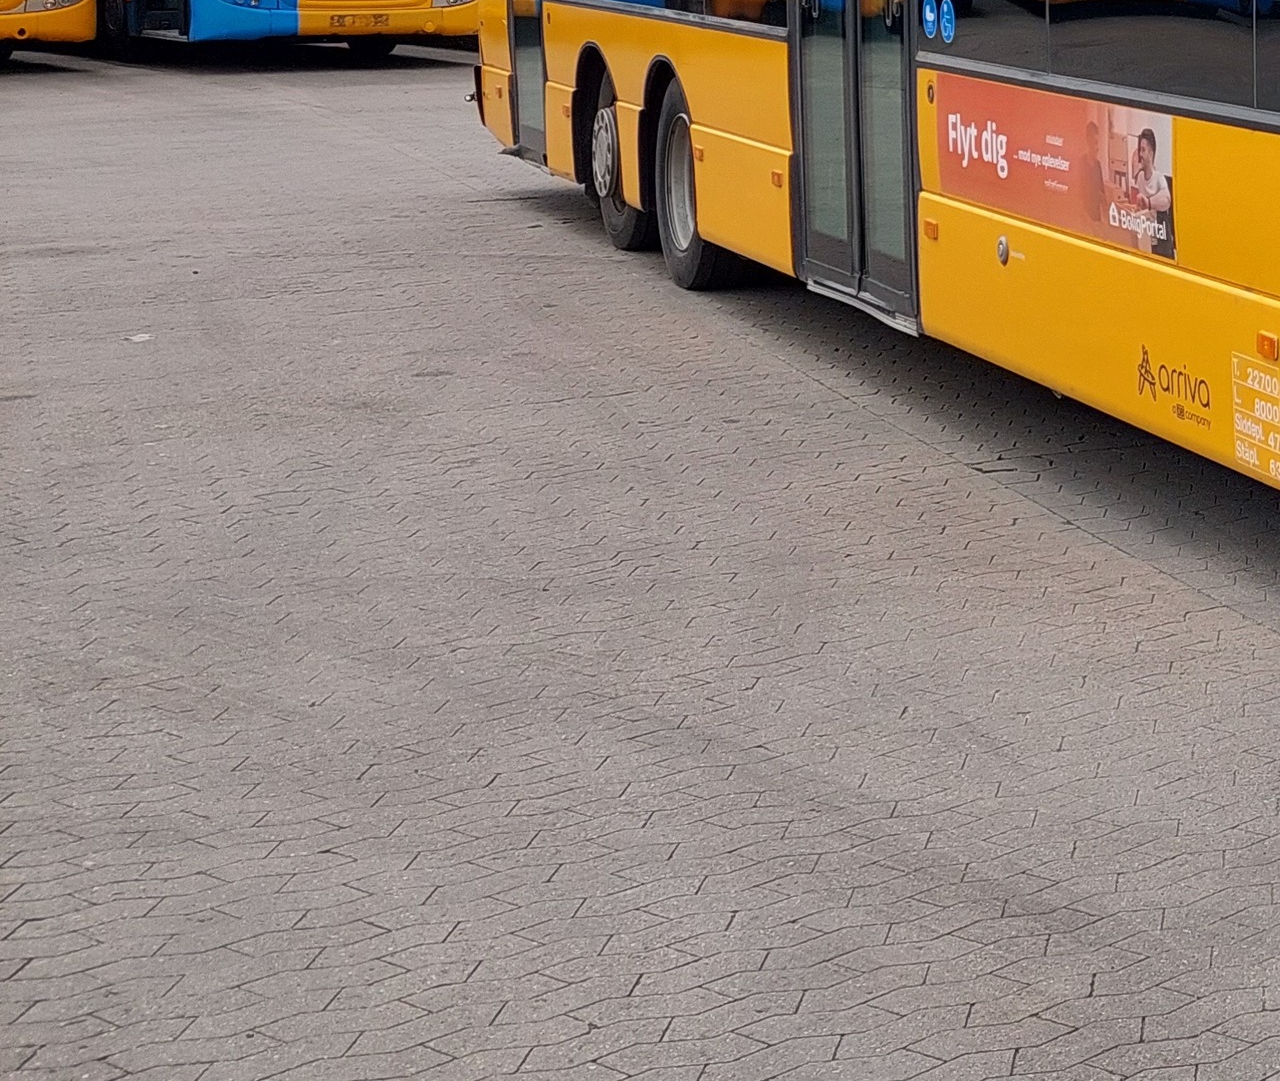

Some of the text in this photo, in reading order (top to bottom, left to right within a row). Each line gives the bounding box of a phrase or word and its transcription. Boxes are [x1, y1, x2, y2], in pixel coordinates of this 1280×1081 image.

[947, 113, 1009, 179] Flyt dig
[1120, 209, 1167, 241] BoligPortal
[1158, 363, 1211, 410] arriva
[1232, 358, 1279, 396] T. 22700
[1185, 409, 1212, 431] company
[1233, 385, 1280, 423] L. 8000
[1234, 412, 1280, 452] Siddepl. 47
[1236, 440, 1259, 466] Ståpl.
